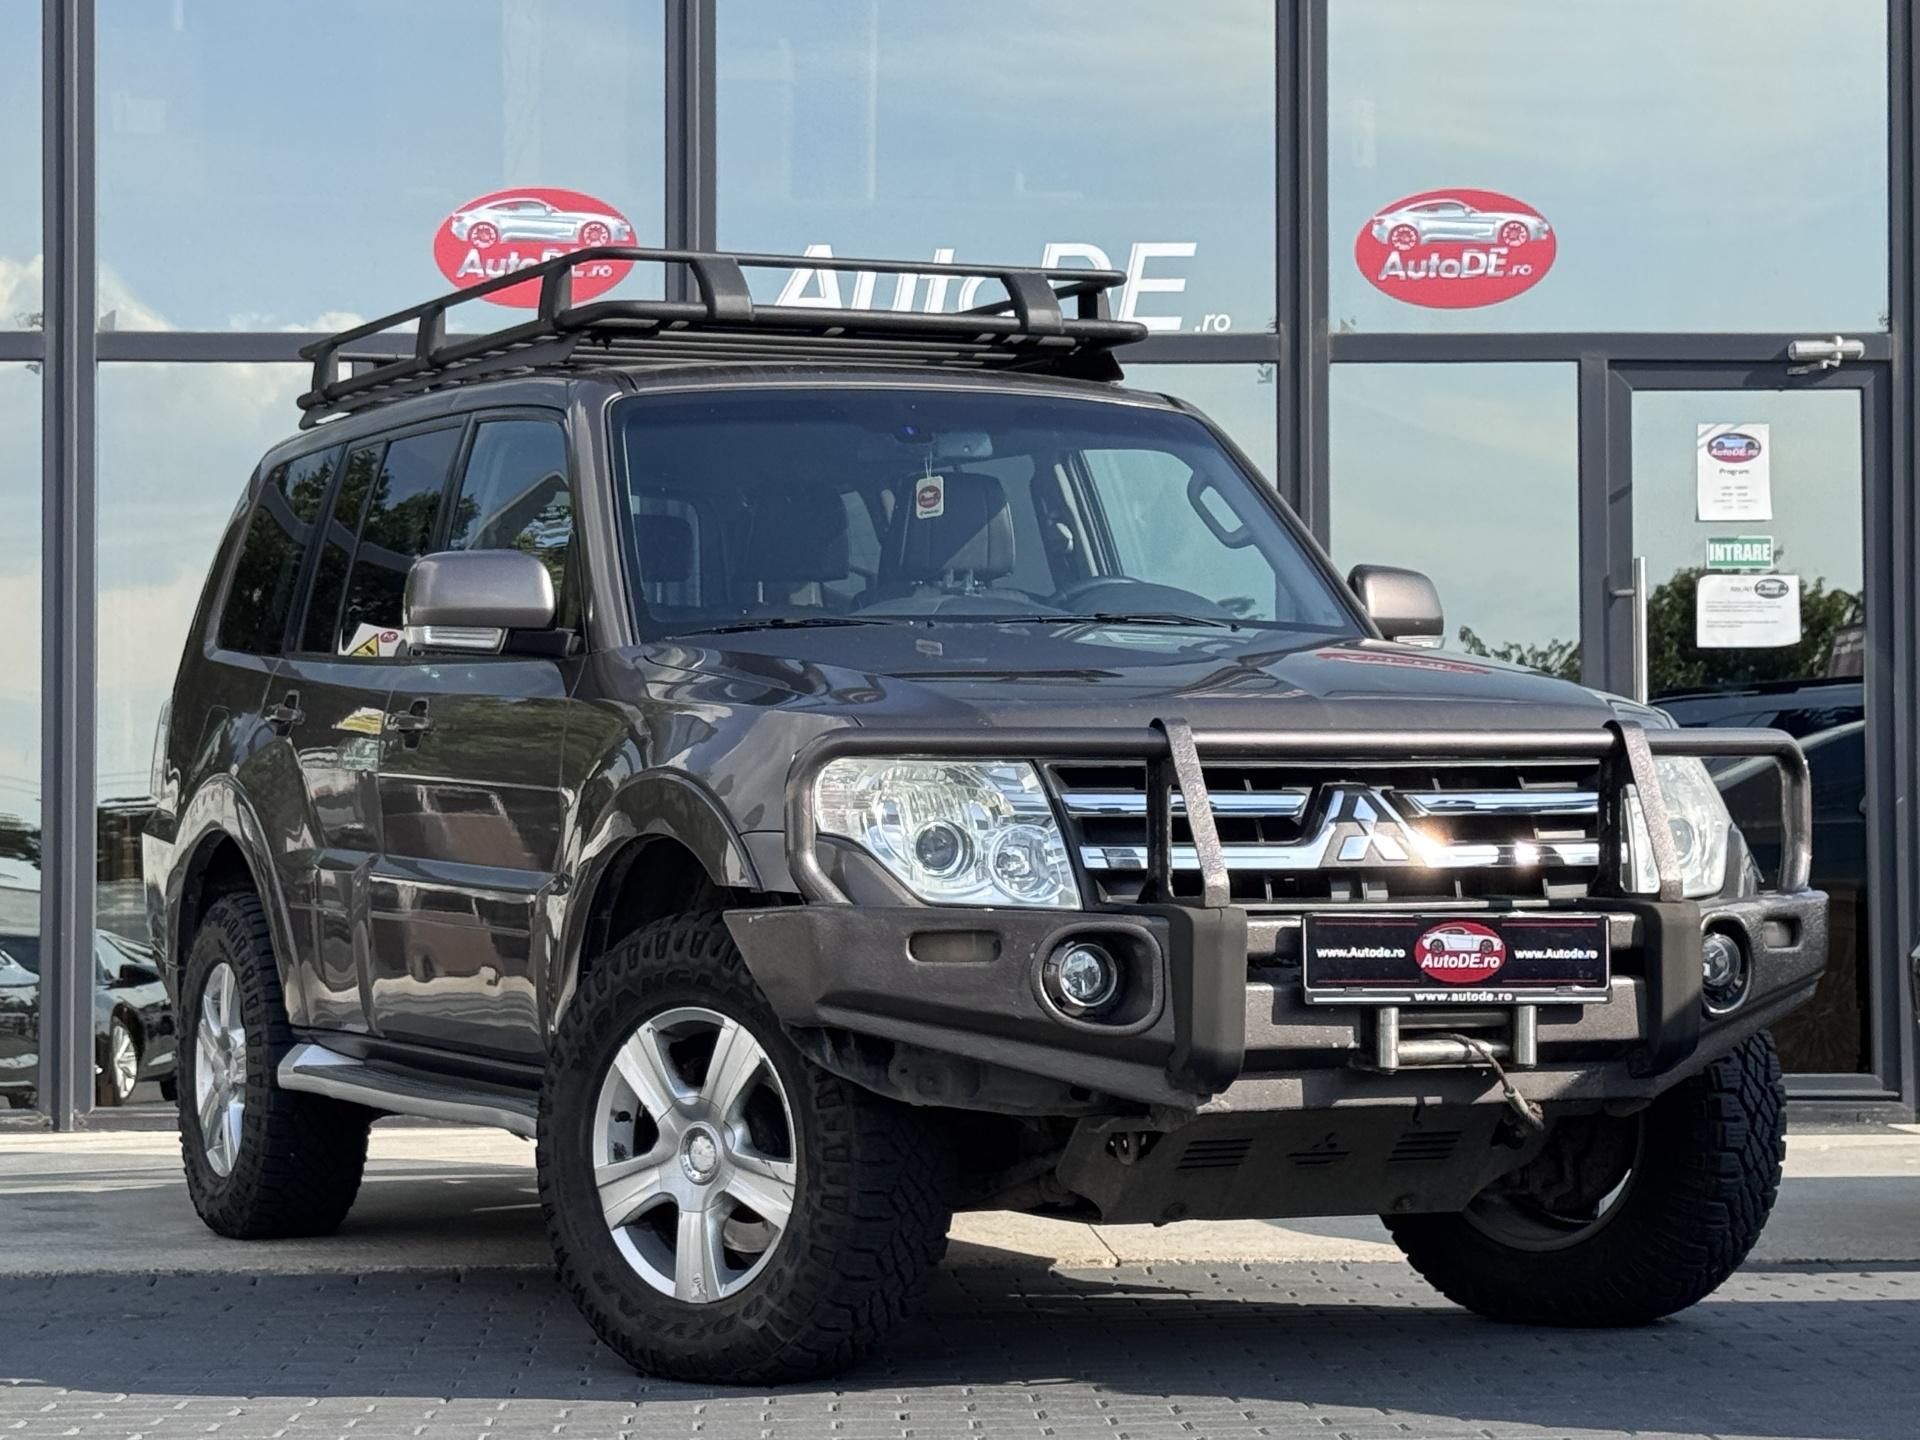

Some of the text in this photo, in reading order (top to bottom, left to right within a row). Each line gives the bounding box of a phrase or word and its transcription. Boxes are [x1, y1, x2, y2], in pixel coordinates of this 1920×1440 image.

[1378, 247, 1533, 280] AutoDE.ro
[1709, 543, 1771, 561] INTRARE
[1316, 946, 1406, 958] www.Autode.ro
[1514, 947, 1599, 959] www.Autode.ro
[1420, 953, 1500, 969] AutoDE.ro
[1414, 991, 1513, 1002] www.autode.ro
